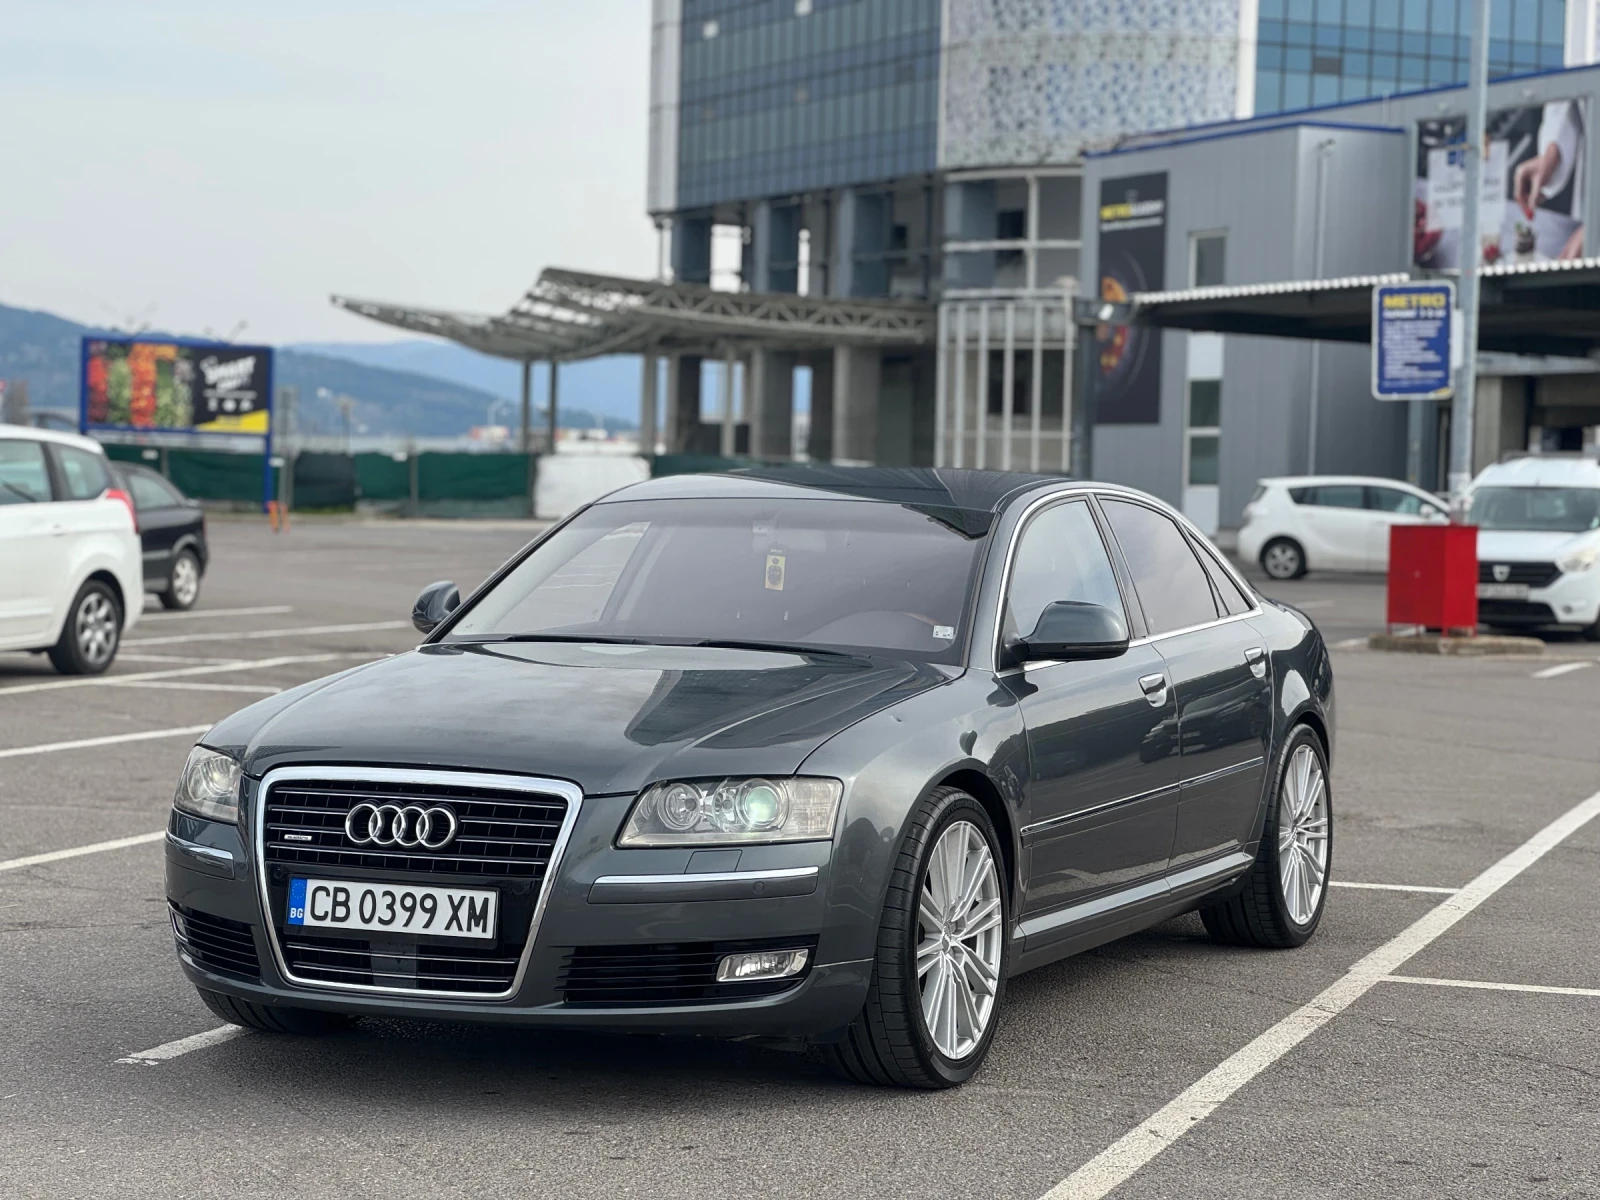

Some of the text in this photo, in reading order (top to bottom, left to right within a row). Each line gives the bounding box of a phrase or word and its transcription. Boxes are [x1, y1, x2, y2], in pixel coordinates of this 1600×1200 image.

[1383, 294, 1446, 309] METRO
[290, 907, 304, 919] BG
[310, 885, 490, 934] CB 0399 XM
